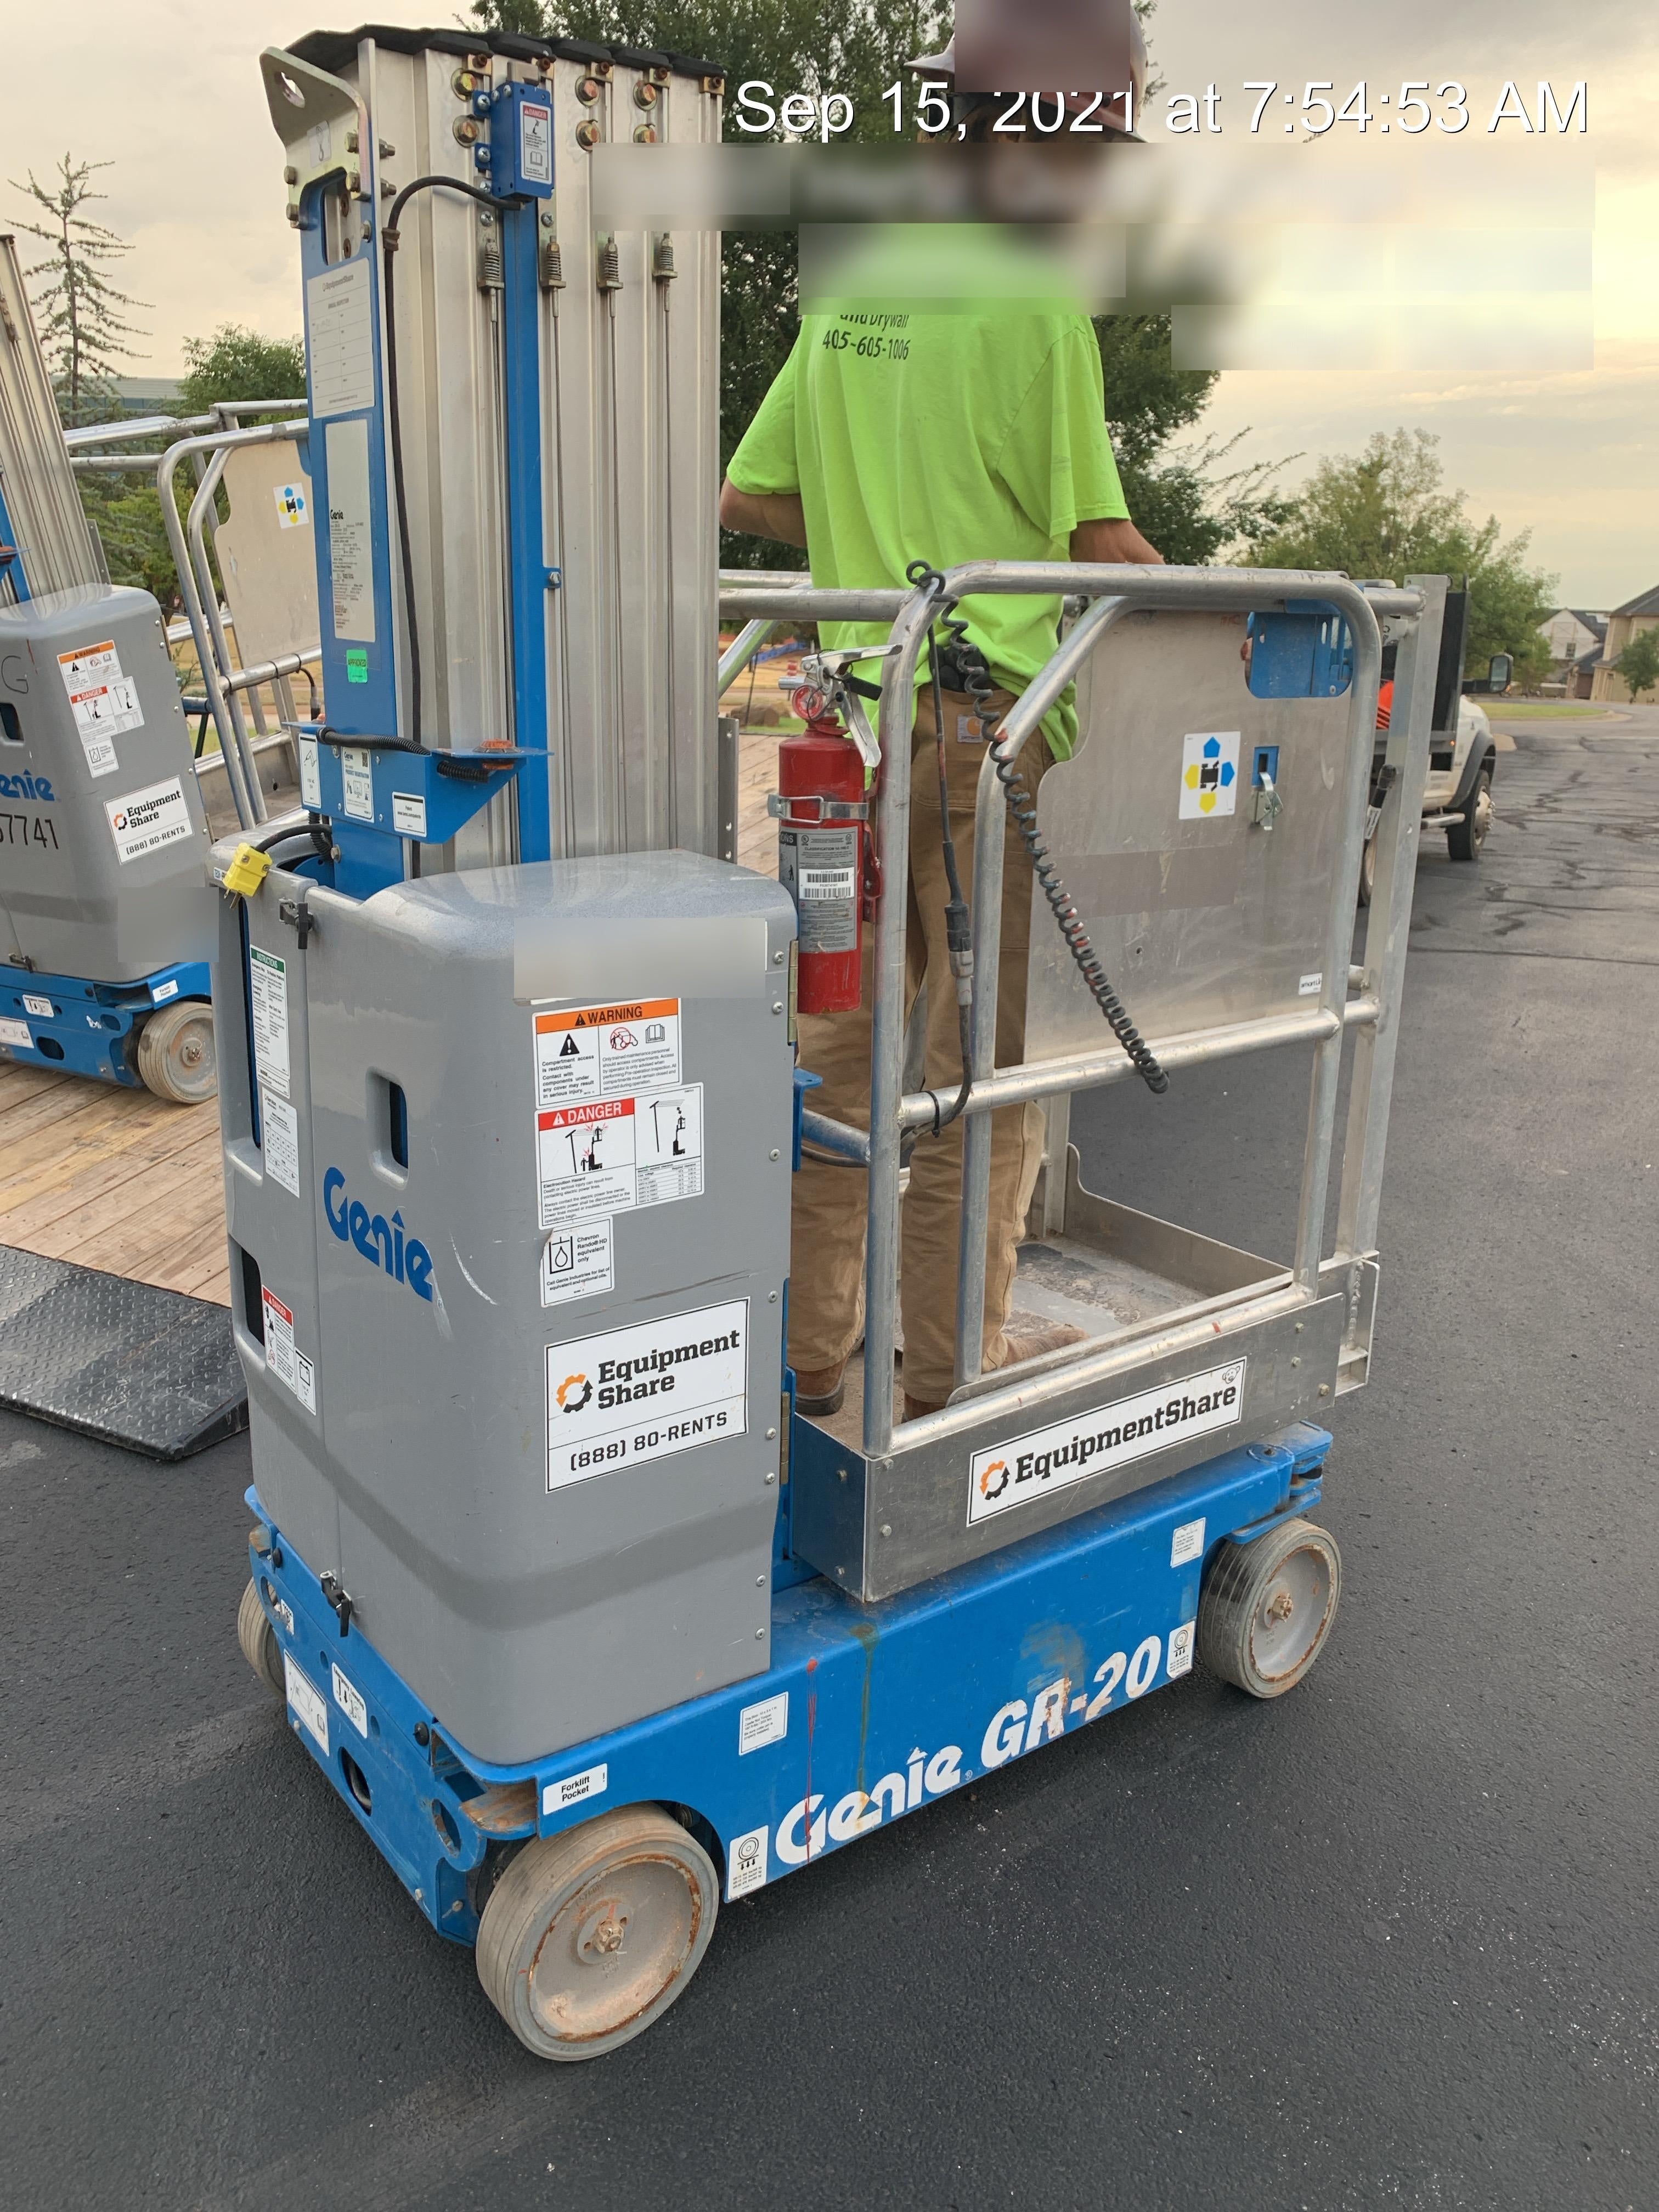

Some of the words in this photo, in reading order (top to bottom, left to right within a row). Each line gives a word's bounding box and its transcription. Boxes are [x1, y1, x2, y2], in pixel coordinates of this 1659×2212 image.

[822, 329, 911, 360] 405-605-1006
[78, 646, 100, 658] WARNING
[82, 687, 103, 699] DANGER
[127, 790, 181, 817] Equipment
[130, 811, 160, 828] Share
[127, 840, 148, 855] (888)
[150, 826, 185, 845] 80-RENTS
[588, 1006, 642, 1024] WARNING
[543, 1057, 575, 1066] Compartment
[567, 1102, 622, 1124] DANGER
[543, 1180, 571, 1189] Electrocution
[595, 1193, 619, 1202] disconnected
[324, 1166, 433, 1302] Genie
[577, 1246, 605, 1256] equivalent
[550, 1281, 572, 1290] equivalent
[582, 1274, 598, 1283] optional
[569, 1272, 590, 1280] Industries
[599, 1330, 740, 1384] Equipment
[599, 1375, 675, 1409] Share
[571, 1440, 626, 1471] (888)
[634, 1412, 727, 1451] 80-RENTS
[1015, 1385, 1235, 1484] EquipmentShare
[981, 1635, 1161, 1768] GR-20
[561, 1776, 590, 1793] Forklift
[562, 1785, 589, 1802] Pocket
